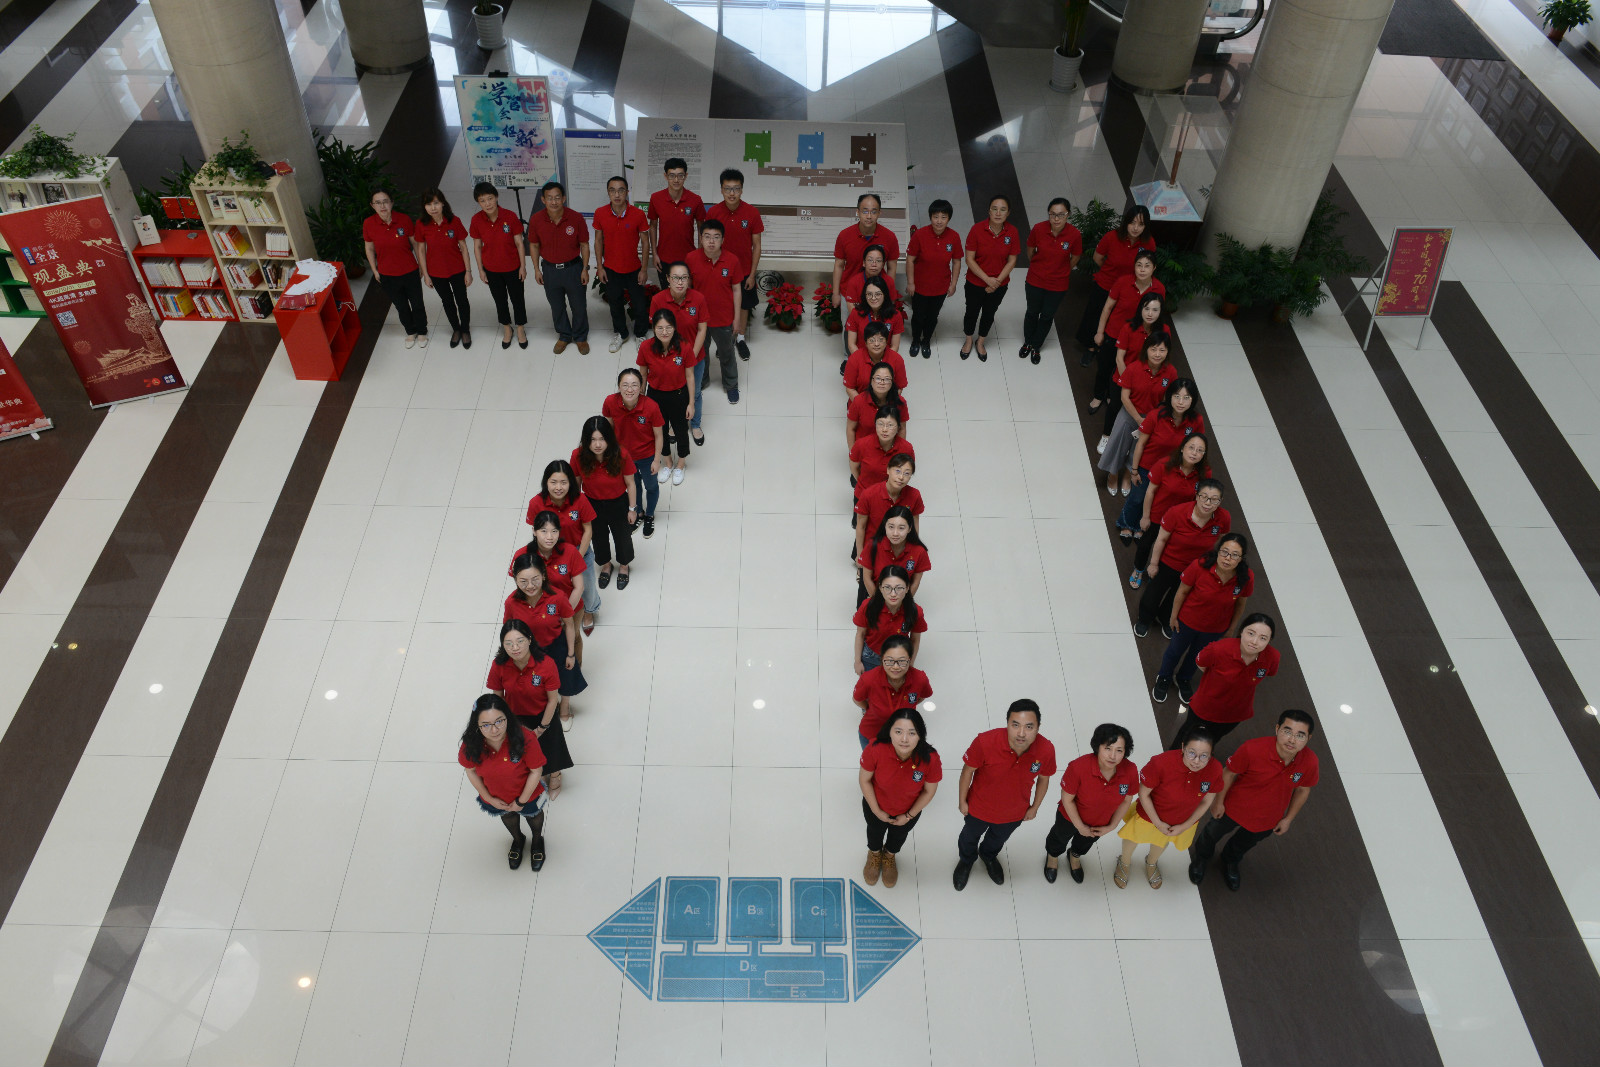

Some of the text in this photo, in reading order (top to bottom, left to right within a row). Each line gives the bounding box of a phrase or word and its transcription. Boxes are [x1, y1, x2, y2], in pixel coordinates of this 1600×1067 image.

[33, 259, 93, 285] 观盛典
[683, 904, 701, 915] A区
[747, 904, 764, 915] B区
[810, 905, 827, 916] C区
[739, 960, 757, 972] D区
